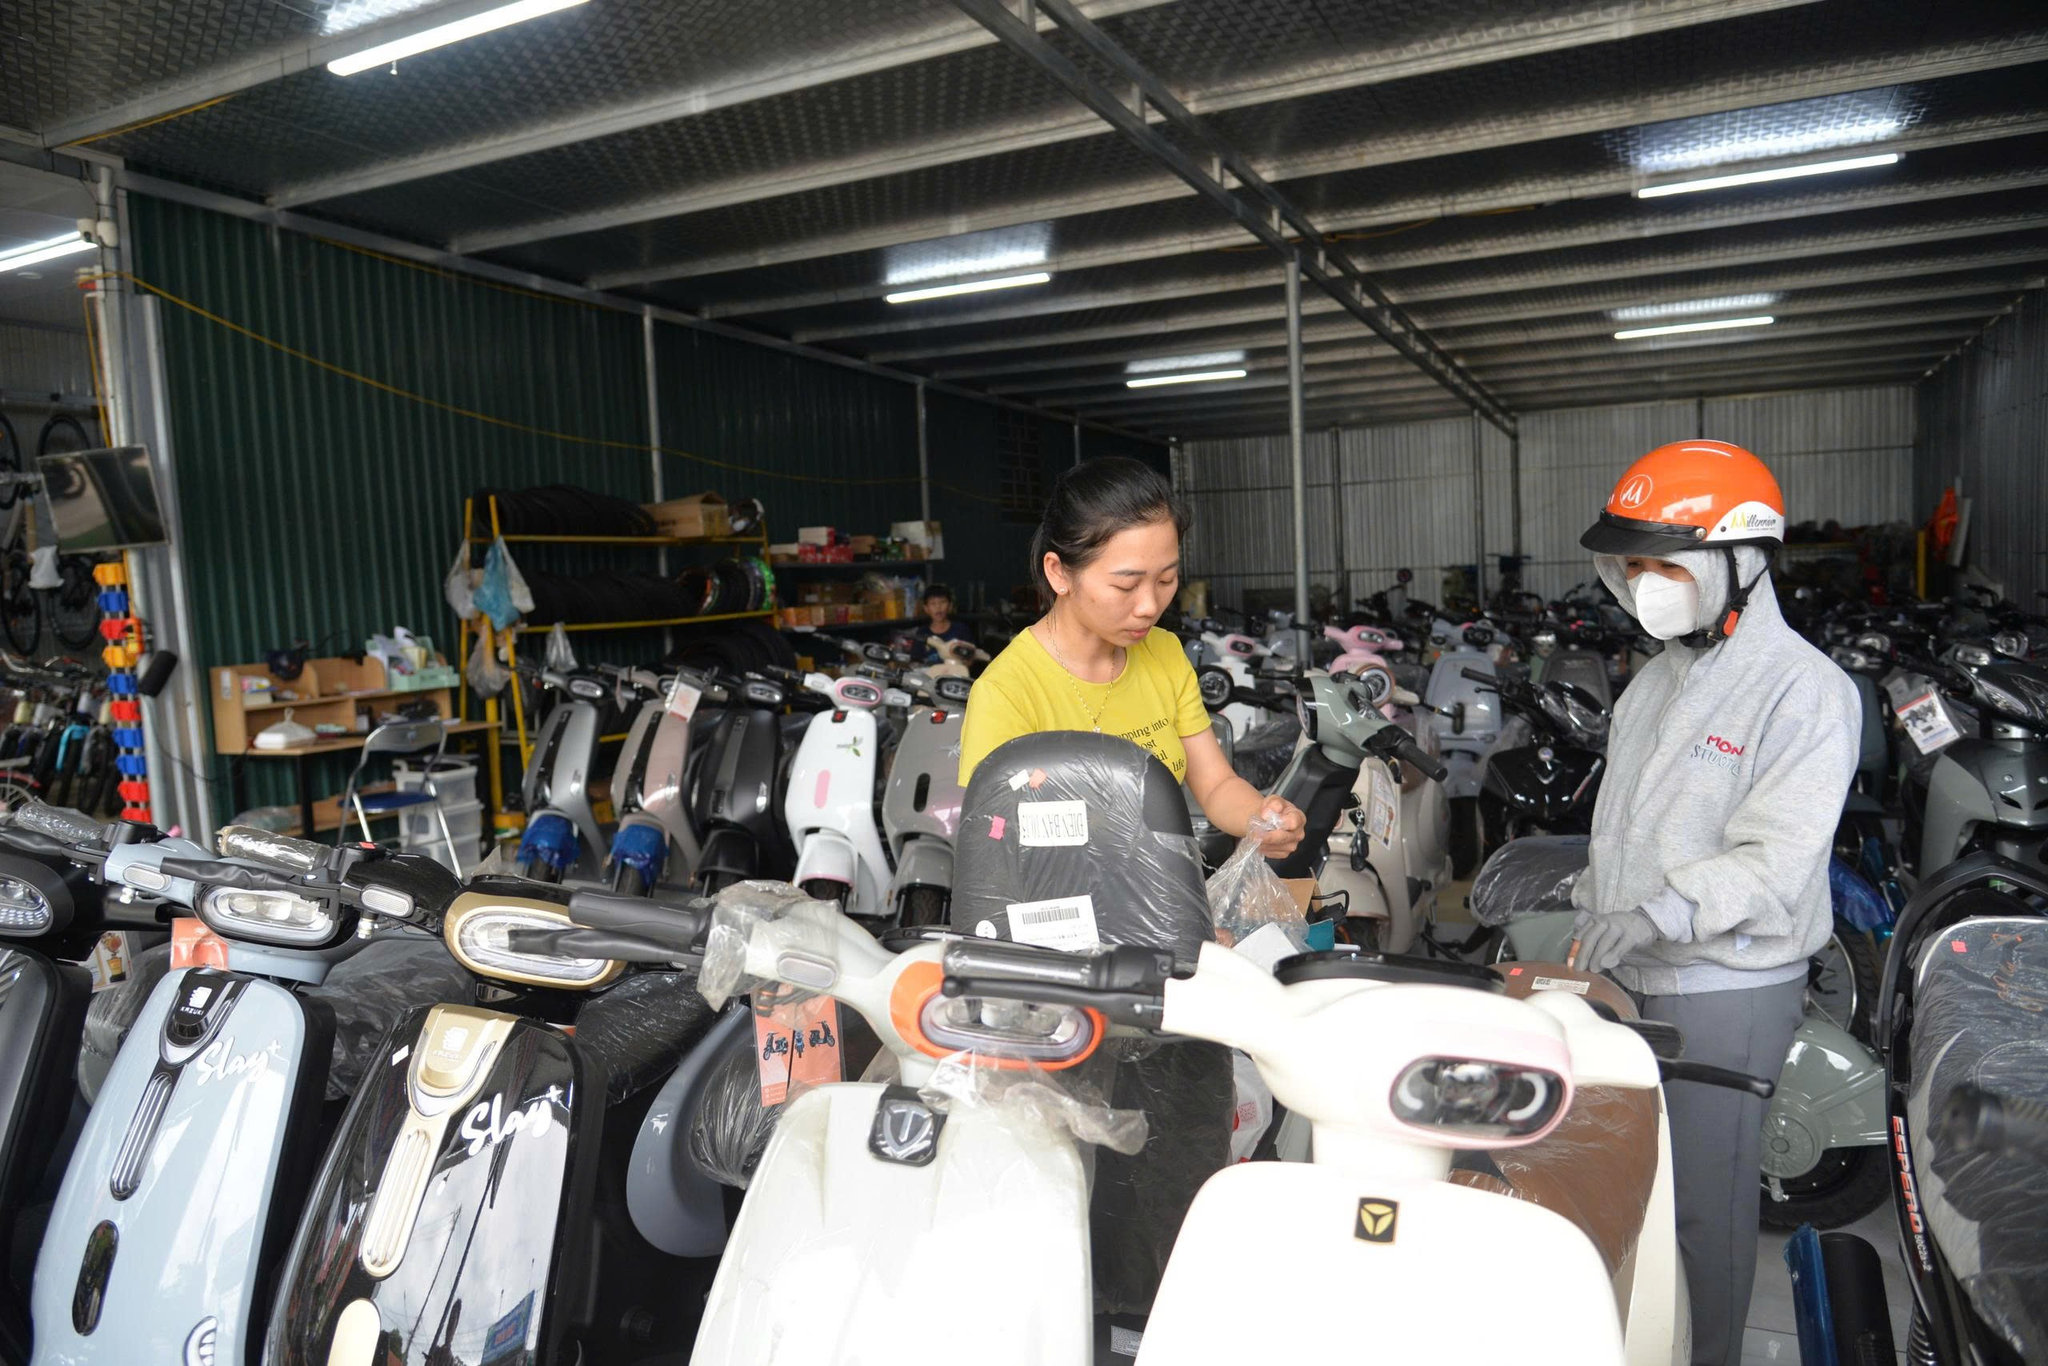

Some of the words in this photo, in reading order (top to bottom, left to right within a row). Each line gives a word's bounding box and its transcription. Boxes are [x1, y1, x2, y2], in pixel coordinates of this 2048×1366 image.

[1151, 717, 1169, 732] into
[1706, 735, 1745, 756] MON
[1172, 758, 1185, 773] life
[1892, 1115, 1924, 1234] ESPERO
